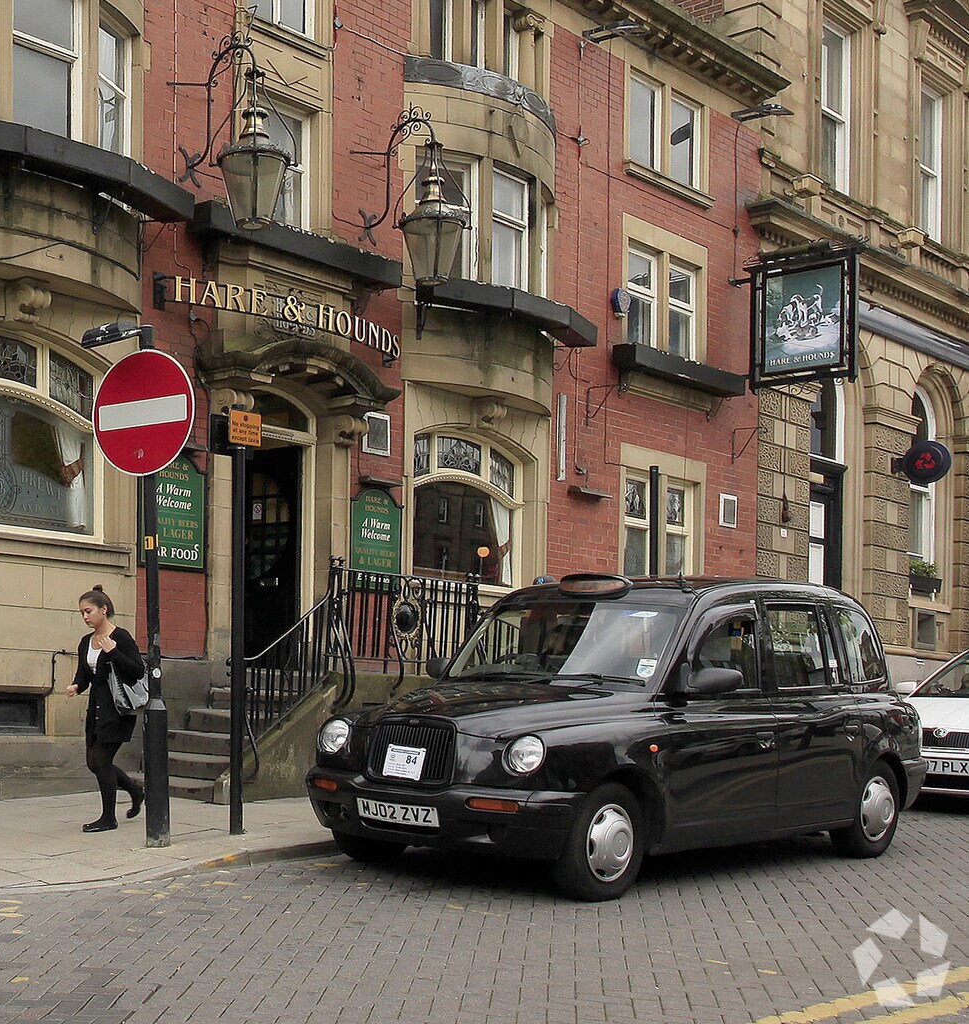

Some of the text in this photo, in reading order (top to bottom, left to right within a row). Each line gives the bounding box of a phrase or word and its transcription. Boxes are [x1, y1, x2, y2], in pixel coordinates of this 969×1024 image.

[174, 275, 268, 317] HARE
[284, 295, 306, 324] &
[318, 304, 401, 359] HOUNDS
[770, 358, 790, 367] HARE
[802, 351, 835, 362] HOUNDS
[158, 470, 190, 482] HOUNDS
[156, 482, 192, 497] A Warm
[155, 494, 192, 510] Welcome
[365, 496, 382, 505] HARE
[157, 516, 199, 529] ALITY BEERS
[362, 517, 391, 531] A Warm
[163, 527, 194, 541] LAGER
[361, 528, 391, 542] Welcome
[171, 547, 198, 561] FOOD
[368, 557, 392, 568] LAGER
[405, 755, 418, 765] 84
[941, 761, 969, 774] PLX
[361, 799, 433, 824] MJ02 ZVZ
